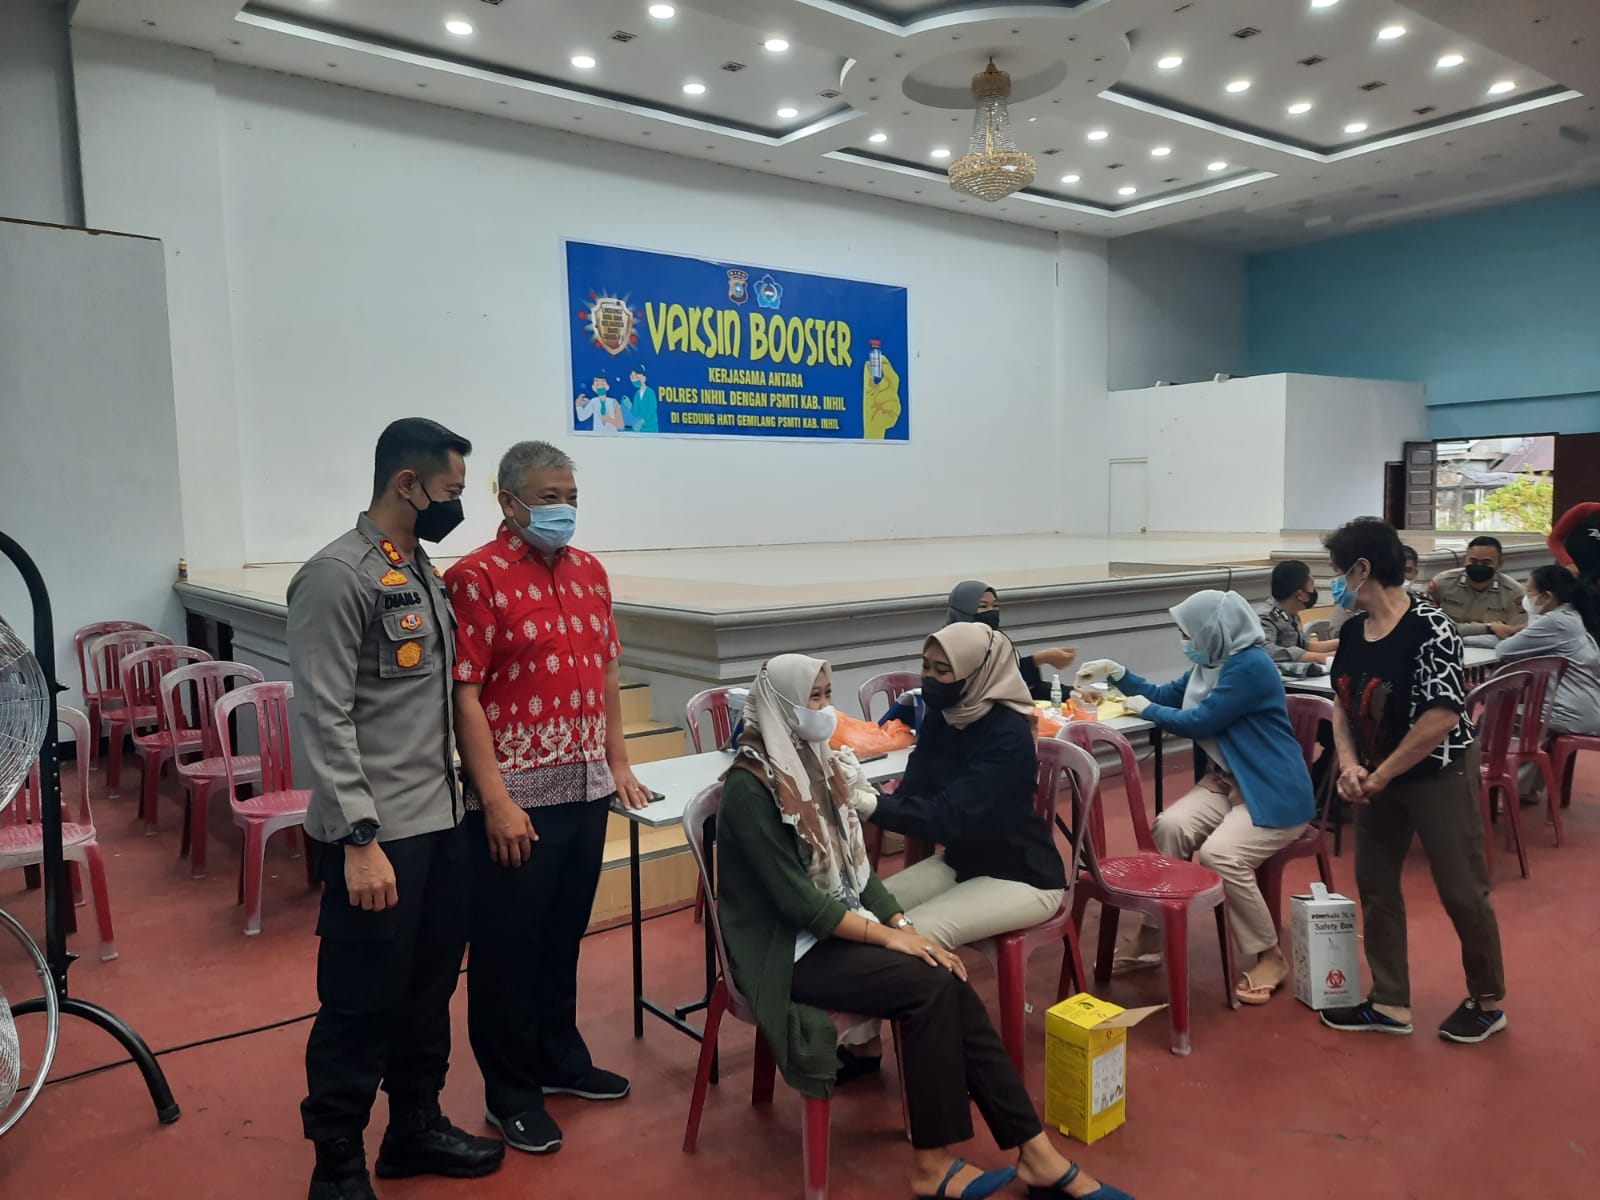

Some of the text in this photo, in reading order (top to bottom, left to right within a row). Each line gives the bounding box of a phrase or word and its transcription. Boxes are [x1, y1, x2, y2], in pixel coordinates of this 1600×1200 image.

[645, 301, 853, 368] VAKSIN BOOSTER
[708, 367, 804, 388] KERJASAMA ANTARA
[658, 386, 846, 411] POLRES INHIL DENGAN PSMTI KAB. INHIL
[671, 411, 840, 430] DI GEDUNG HATI GEMILANG PSMTI KAB. INHIL
[1314, 922, 1337, 931] Safety
